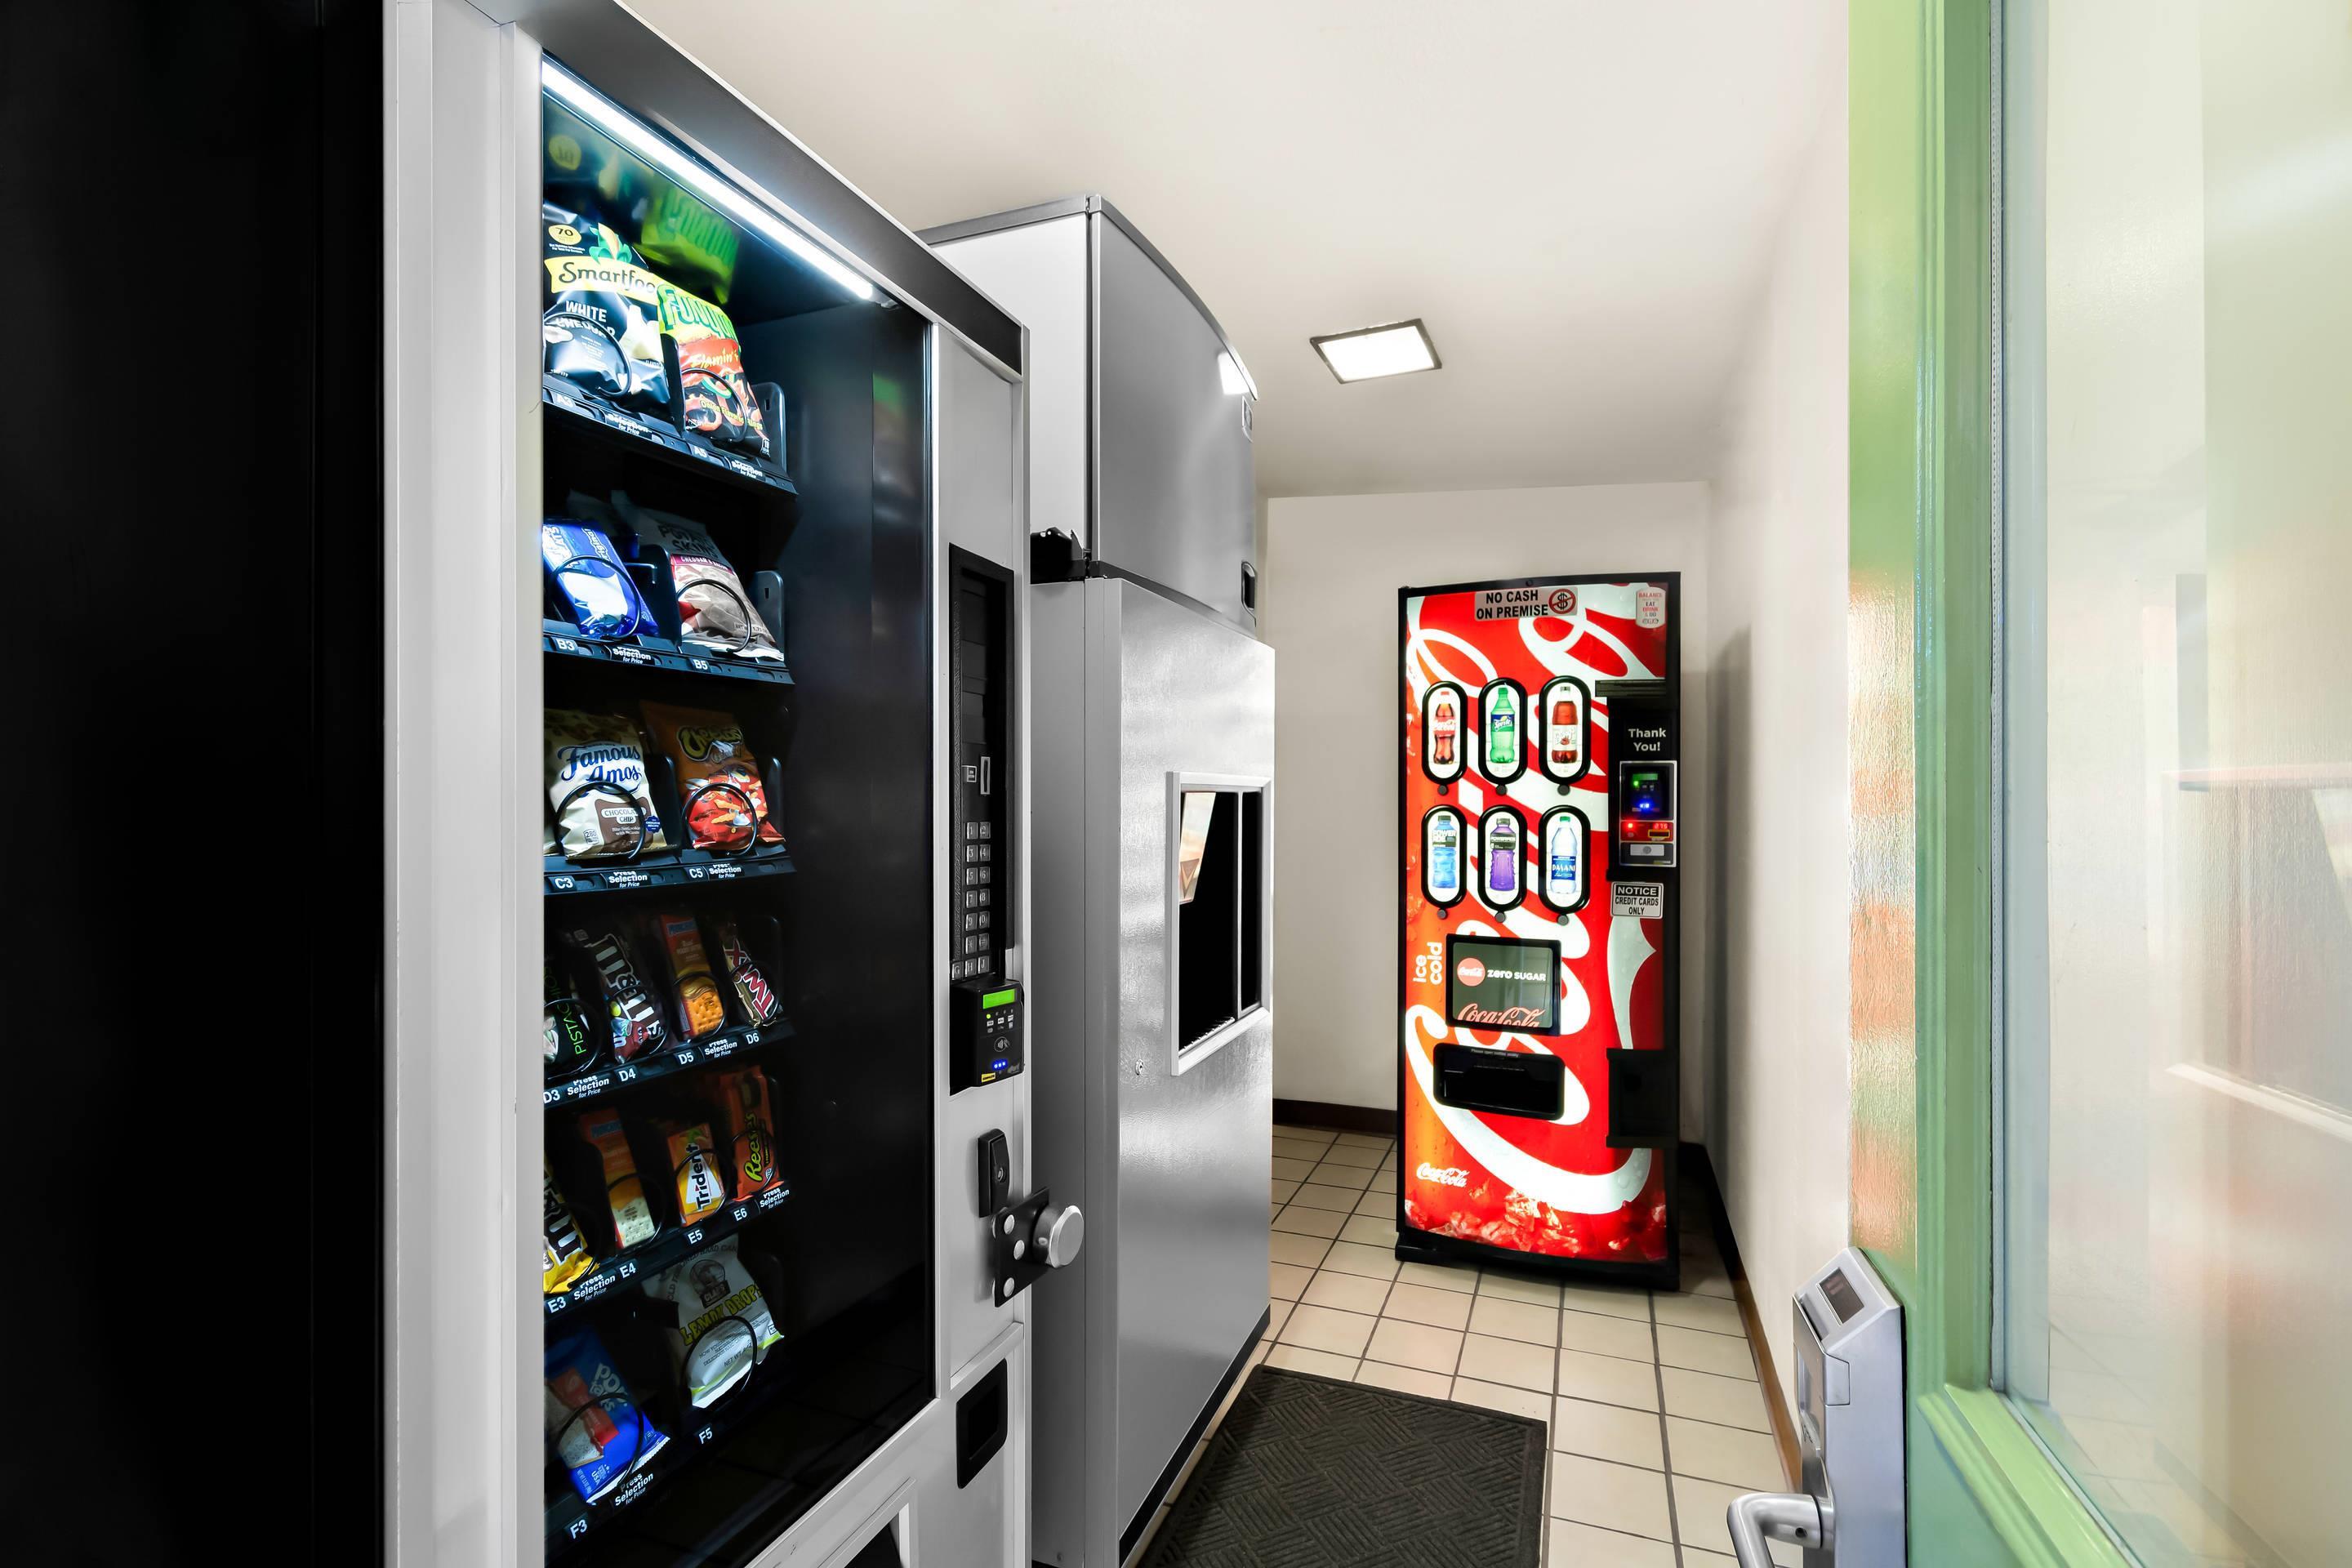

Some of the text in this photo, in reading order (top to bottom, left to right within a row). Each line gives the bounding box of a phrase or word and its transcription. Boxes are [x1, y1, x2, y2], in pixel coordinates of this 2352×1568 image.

[555, 227, 573, 237] 70
[559, 261, 656, 293] Smartfoo
[565, 300, 608, 323] WHITE
[1486, 590, 1539, 604] NO CASH
[1476, 604, 1549, 620] ON PREMISE
[557, 639, 576, 651] B3
[612, 648, 652, 662] Selection
[630, 657, 644, 665] Price
[694, 659, 708, 670] B5
[1494, 718, 1512, 732] Sprite
[1628, 728, 1666, 738] Thank
[1633, 742, 1661, 752] You!
[557, 744, 641, 782] Famous
[587, 765, 643, 784] Amos
[688, 867, 703, 879] C5
[709, 866, 742, 875] Selection
[1552, 864, 1576, 872] DASANI
[555, 876, 573, 889] C3
[608, 874, 648, 884] Selection
[1618, 886, 1657, 896] NOTICE
[1615, 897, 1659, 906] CREDIT CARDS
[1628, 906, 1645, 915] ONLY
[1413, 954, 1427, 983] Ice
[1427, 942, 1443, 986] cold
[1487, 969, 1546, 982] zero SUGAR
[746, 1032, 760, 1045] D6
[705, 1042, 737, 1056] Selection
[678, 1052, 694, 1065] D5
[618, 1069, 636, 1082] D4
[568, 1077, 609, 1096] Selection
[587, 1088, 601, 1097] Price
[543, 1089, 560, 1103] D3
[686, 1143, 710, 1211] Trident
[760, 1189, 790, 1208] Selection
[774, 1198, 784, 1206] Price
[734, 1207, 748, 1222] E6
[688, 1229, 703, 1245] E5
[619, 1262, 636, 1279] E4
[573, 1275, 616, 1300] Selection
[585, 1287, 607, 1302] for Price
[547, 1296, 567, 1313] E3
[699, 1428, 713, 1444] F5
[615, 1473, 653, 1506] Selection
[620, 1472, 643, 1493] Press
[626, 1487, 647, 1506] for Price
[570, 1519, 588, 1539] F3
